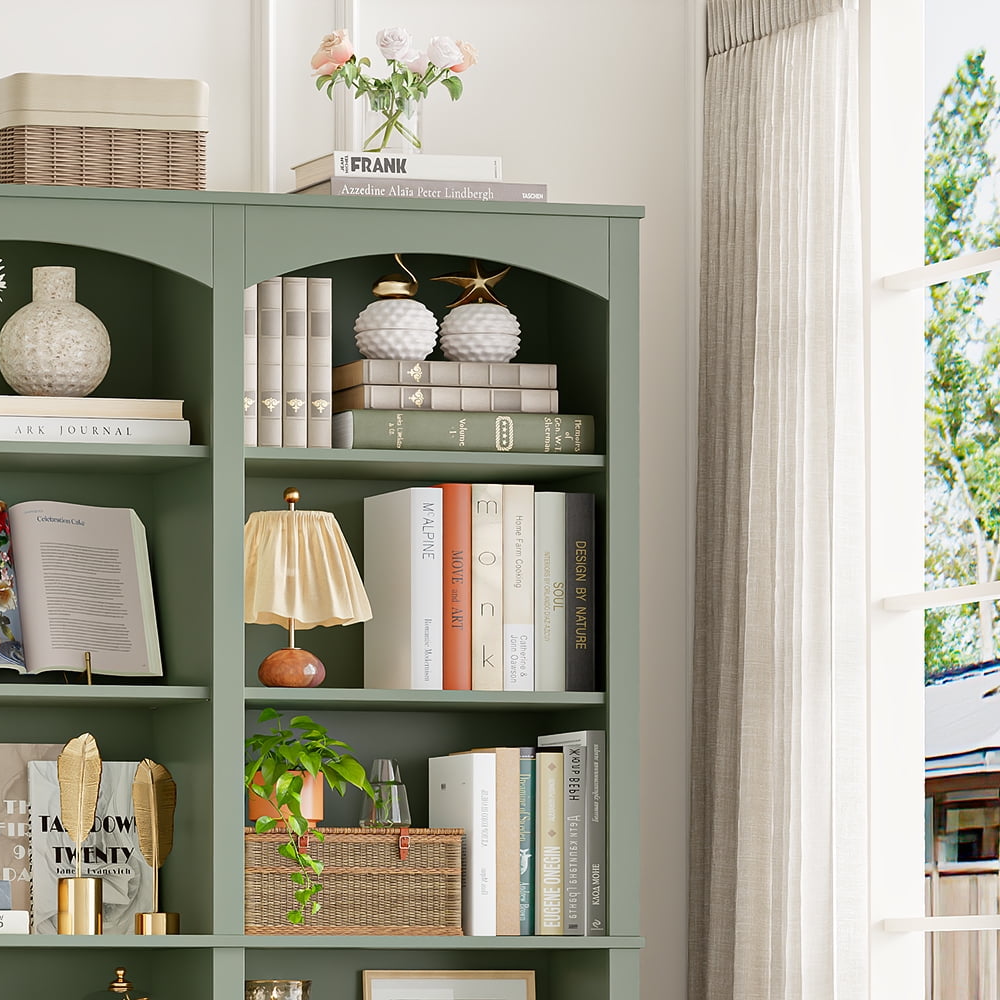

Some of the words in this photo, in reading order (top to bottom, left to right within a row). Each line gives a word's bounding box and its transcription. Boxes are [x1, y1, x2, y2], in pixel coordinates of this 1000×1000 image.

[350, 156, 407, 174] FRANK
[341, 184, 386, 196] Azzedine
[417, 185, 441, 198] Peter
[445, 187, 495, 201] Lindbergh
[521, 192, 544, 200] TASCHEN
[15, 425, 46, 435] ARK
[60, 425, 134, 437] JOURNAL
[459, 418, 467, 448] Volume
[544, 416, 552, 453] Sherman
[574, 419, 582, 452] Memoirs
[515, 515, 524, 537] Home
[515, 540, 524, 556] Farm
[451, 550, 463, 585] MOVE
[575, 540, 587, 583] DESIGN
[513, 558, 524, 589] Cooking
[552, 582, 564, 611] SOUL
[575, 587, 587, 602] BY
[451, 607, 463, 630] ART
[575, 606, 587, 650] NATURE
[52, 846, 135, 864] TWENTY
[543, 846, 561, 884] ONEGIN
[56, 867, 76, 875] Jane
[87, 867, 131, 875] Evanovich
[592, 863, 601, 885] МОНЕ
[592, 885, 601, 906] КЛОД
[543, 887, 561, 928] EUGENE
